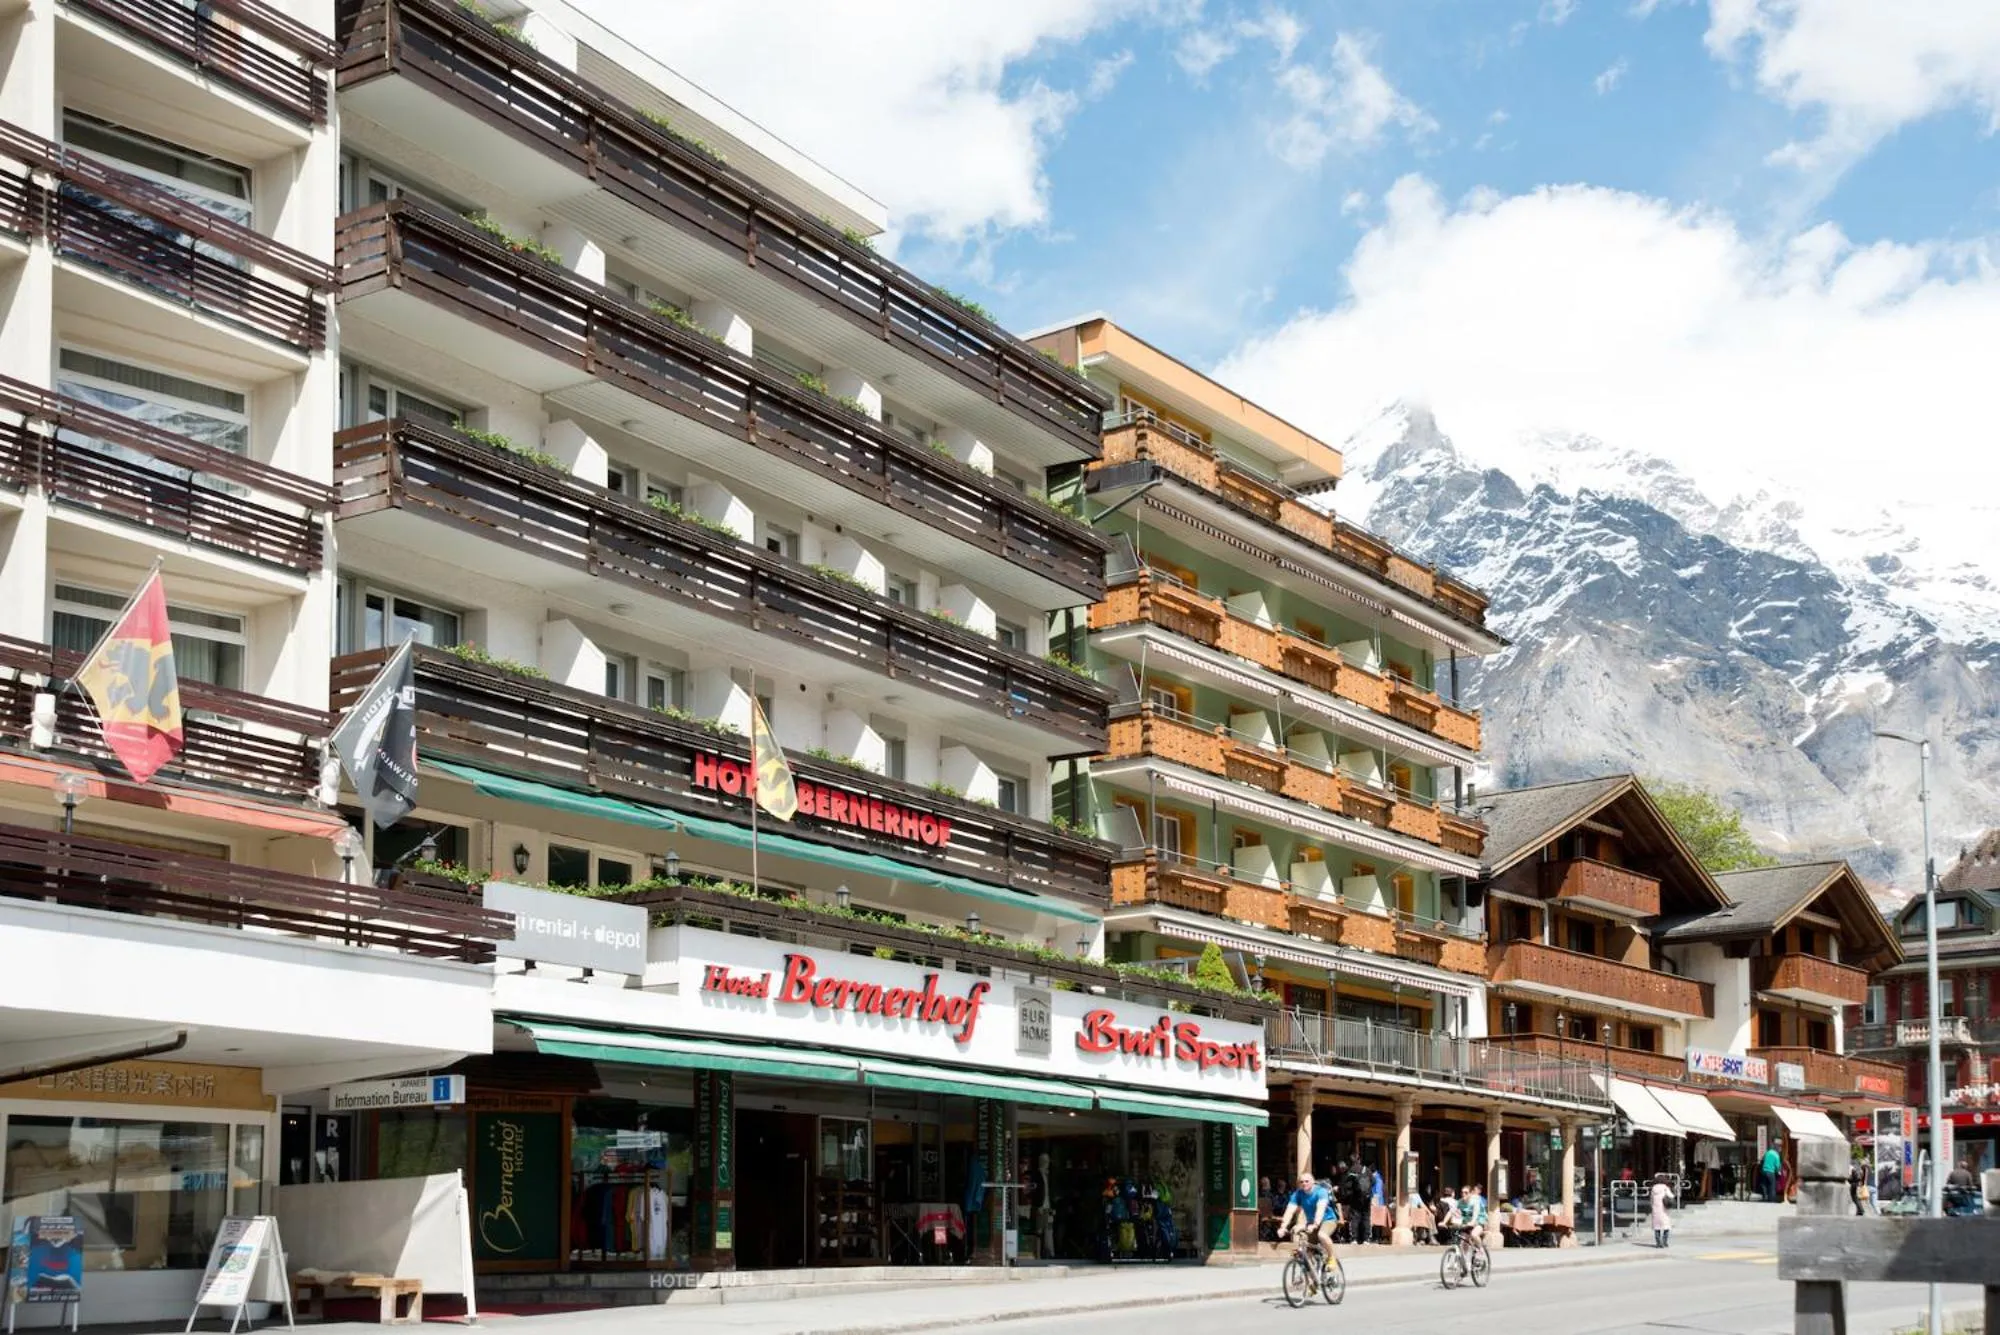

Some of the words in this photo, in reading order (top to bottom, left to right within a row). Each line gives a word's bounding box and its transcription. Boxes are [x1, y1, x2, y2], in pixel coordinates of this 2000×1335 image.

[694, 751, 758, 800] HOT
[797, 781, 951, 848] BERNERHOF
[528, 916, 577, 939] rental
[594, 924, 641, 949] depot
[703, 964, 771, 998] Hotel
[776, 953, 992, 1043] Bernerhof
[1021, 1025, 1050, 1042] HOME
[1076, 1008, 1171, 1061] Buri
[1175, 1021, 1262, 1072] Sport
[335, 1091, 390, 1109] Information
[393, 1090, 427, 1105] Bureau
[700, 1068, 711, 1134] RENTAL
[514, 1125, 524, 1172] HOTEL
[700, 1139, 710, 1169] SKI
[718, 1080, 730, 1184] Bernerhof
[479, 1119, 530, 1253] Bernerhof
[1213, 1169, 1223, 1190] SKI
[650, 1273, 701, 1288] HOTEL
